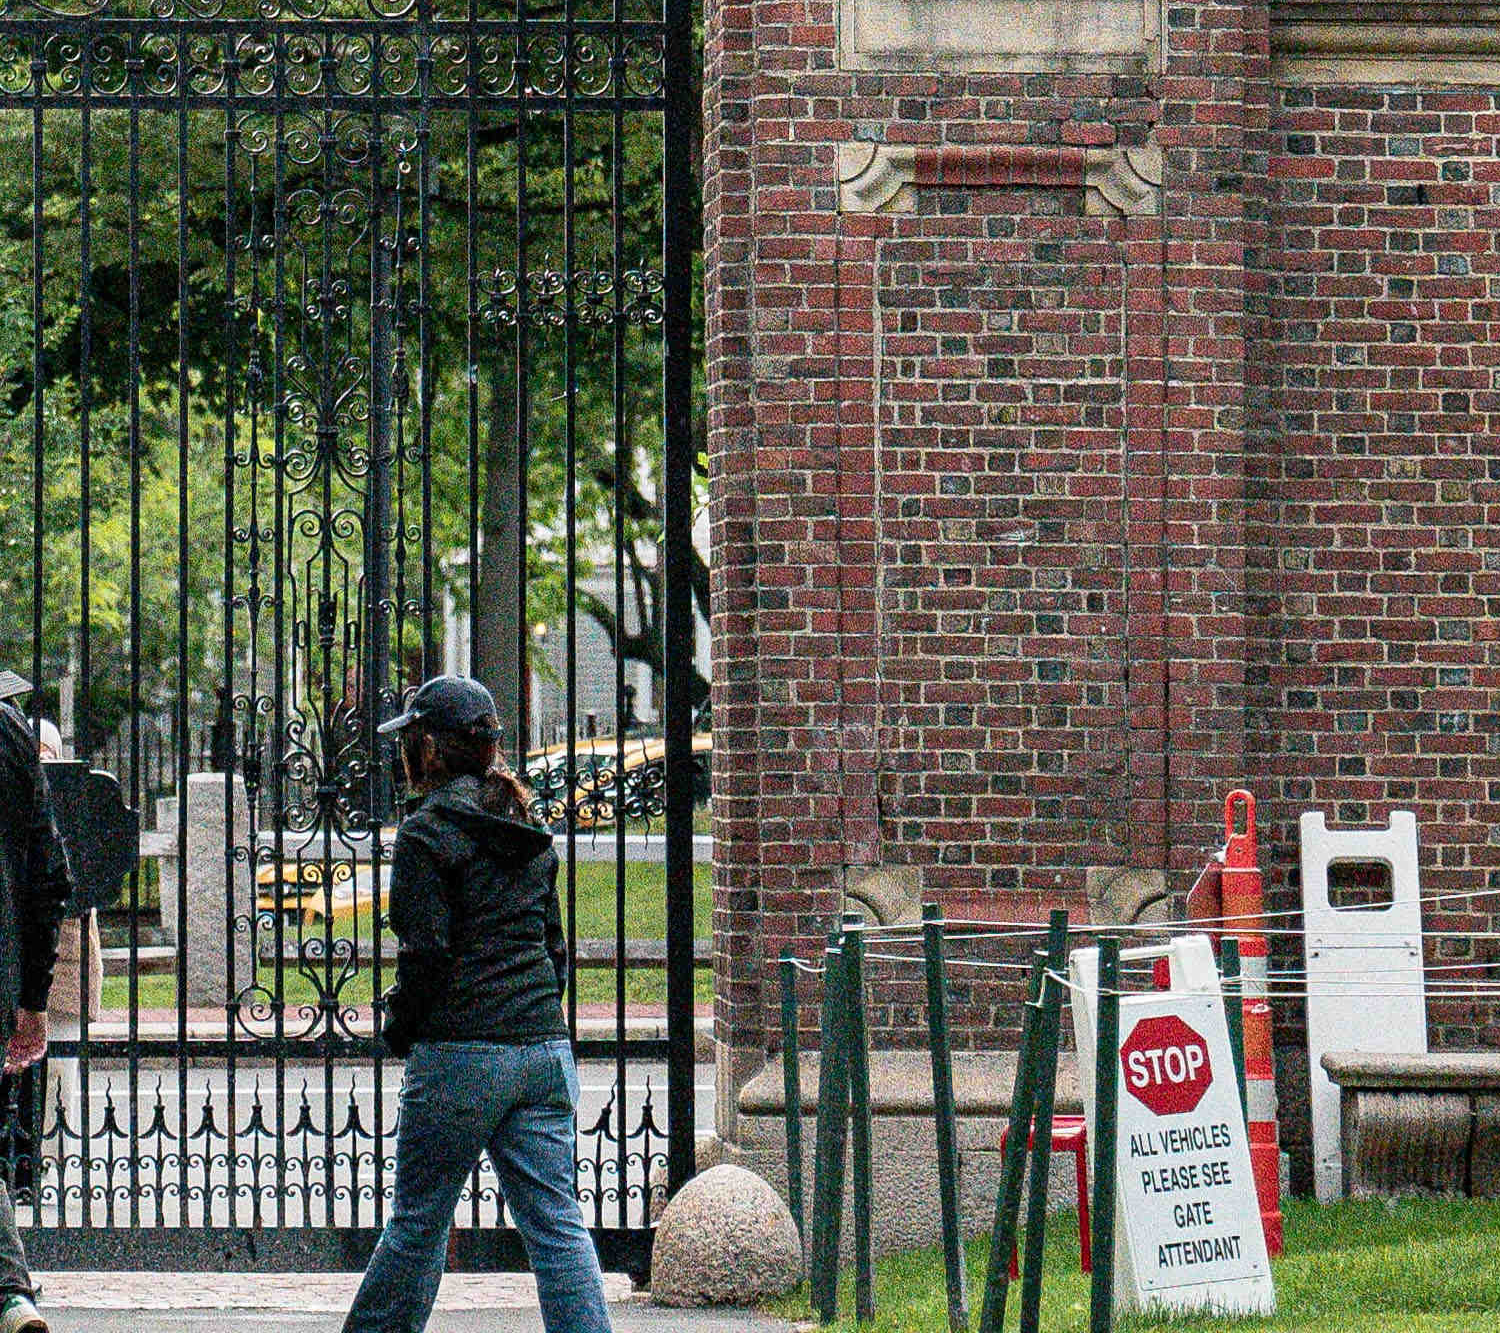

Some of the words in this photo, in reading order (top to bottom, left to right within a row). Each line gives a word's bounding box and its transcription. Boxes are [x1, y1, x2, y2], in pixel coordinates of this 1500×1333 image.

[1128, 1044, 1204, 1088] STOP
[1130, 1132, 1158, 1158] ALL
[1159, 1123, 1232, 1154] VEHICLES
[1141, 1165, 1200, 1194] PLEASE
[1203, 1162, 1232, 1186] SEE
[1174, 1201, 1214, 1229] GATE
[1158, 1235, 1241, 1269] ATTENDANT
